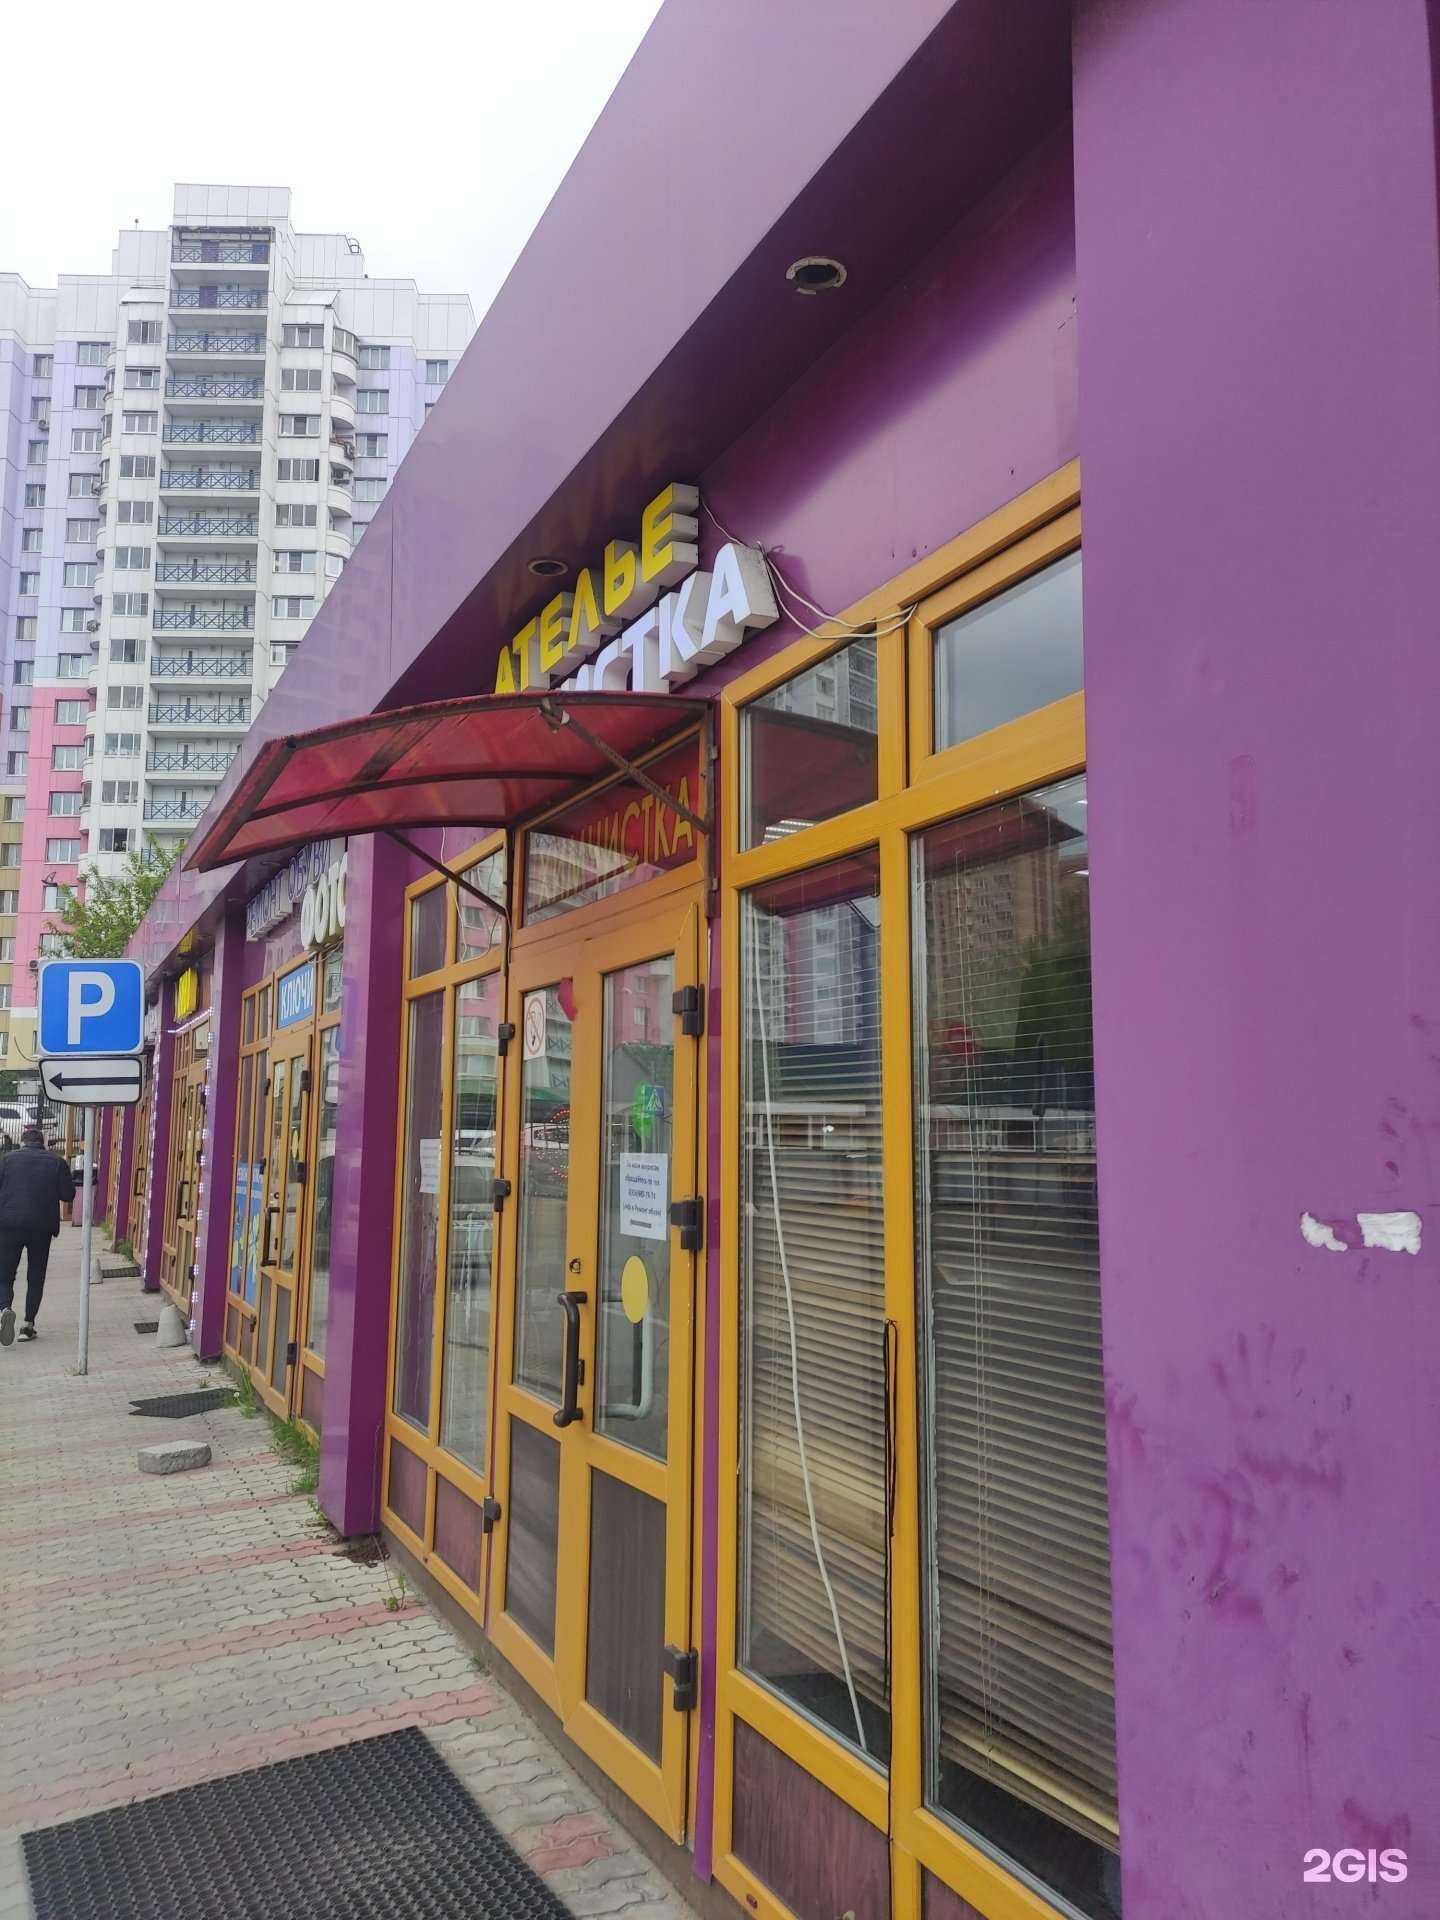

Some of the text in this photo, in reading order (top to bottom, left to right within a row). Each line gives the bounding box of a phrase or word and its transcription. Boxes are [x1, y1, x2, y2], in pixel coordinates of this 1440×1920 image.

[495, 482, 680, 695] АТЕЛЬЕ
[67, 971, 116, 1045] P
[281, 966, 315, 1021] КЛЮЧИ
